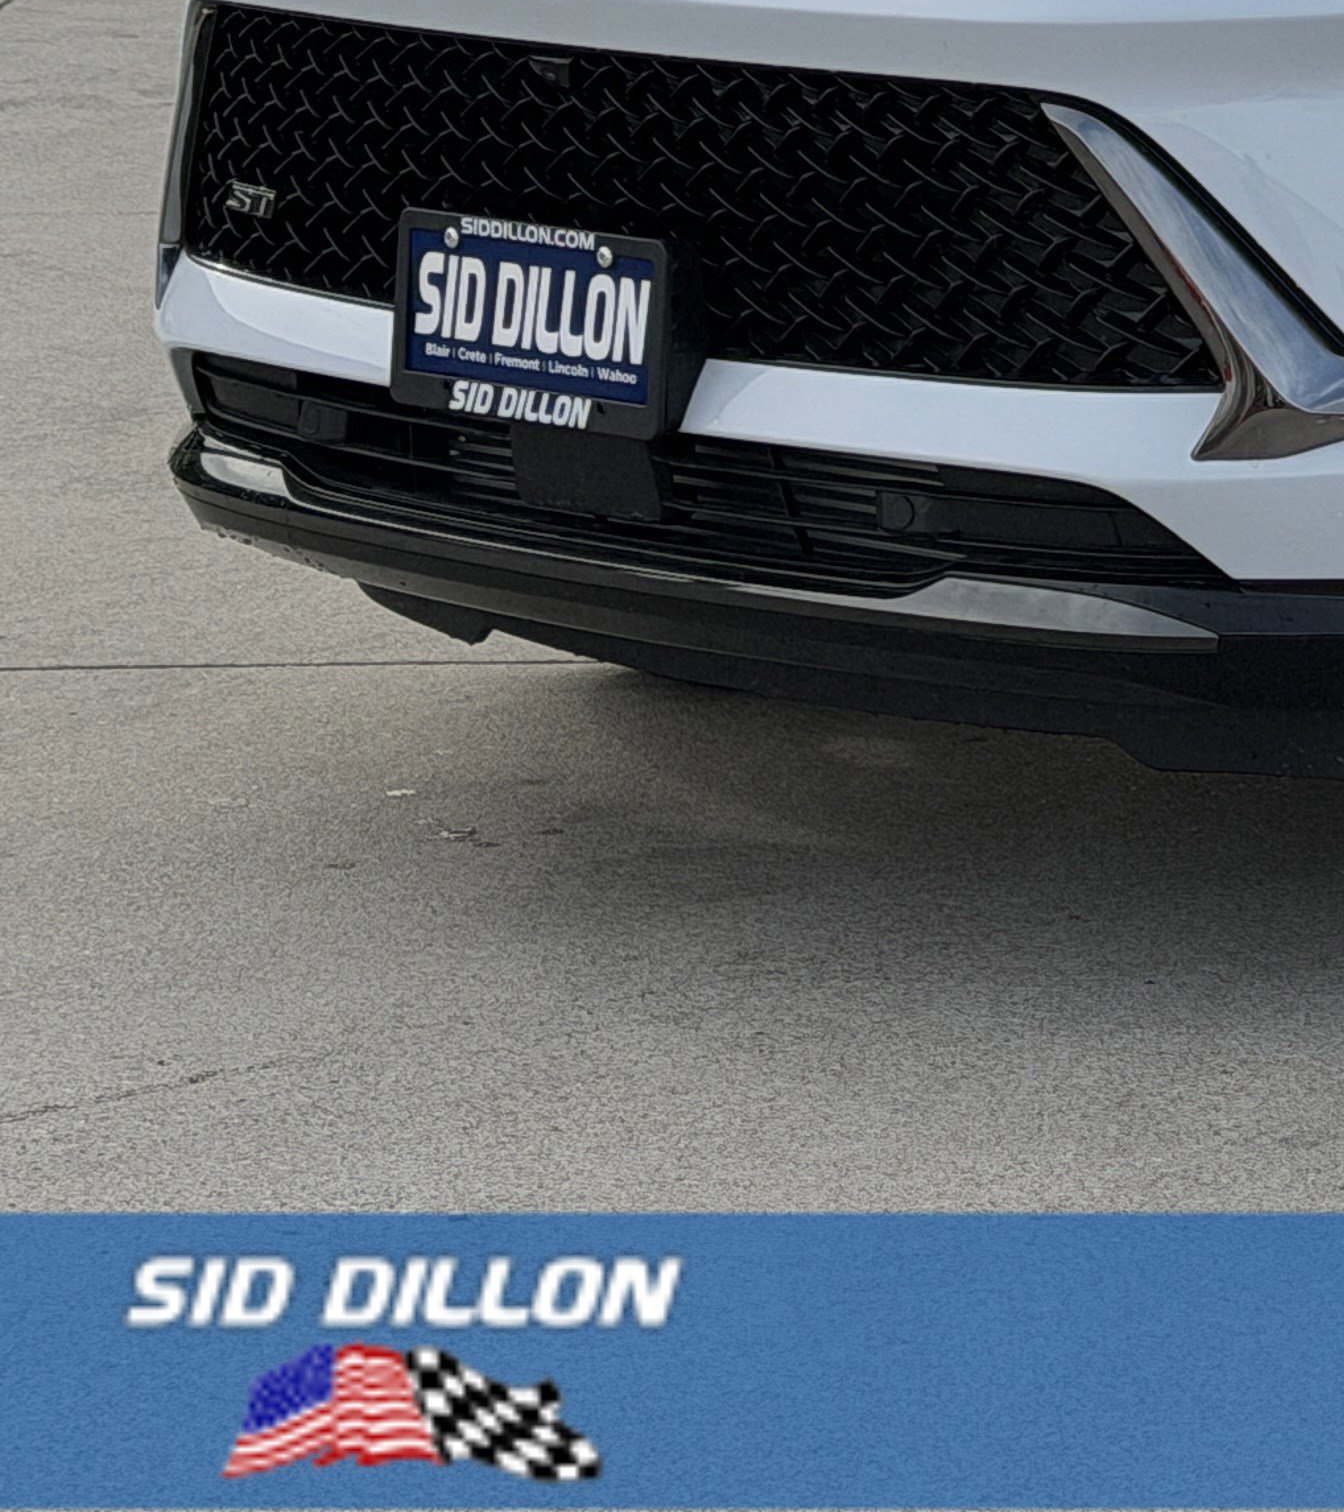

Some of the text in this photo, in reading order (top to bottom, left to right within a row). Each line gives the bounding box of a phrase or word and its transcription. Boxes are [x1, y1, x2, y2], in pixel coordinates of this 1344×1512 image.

[225, 178, 277, 219] ST
[461, 217, 595, 251] SIDDILLON.COM
[414, 251, 651, 365] SID DILLON
[425, 342, 638, 385] Blair Crete Fremont Lincoln Wahoo
[449, 380, 592, 430] SID DILLON
